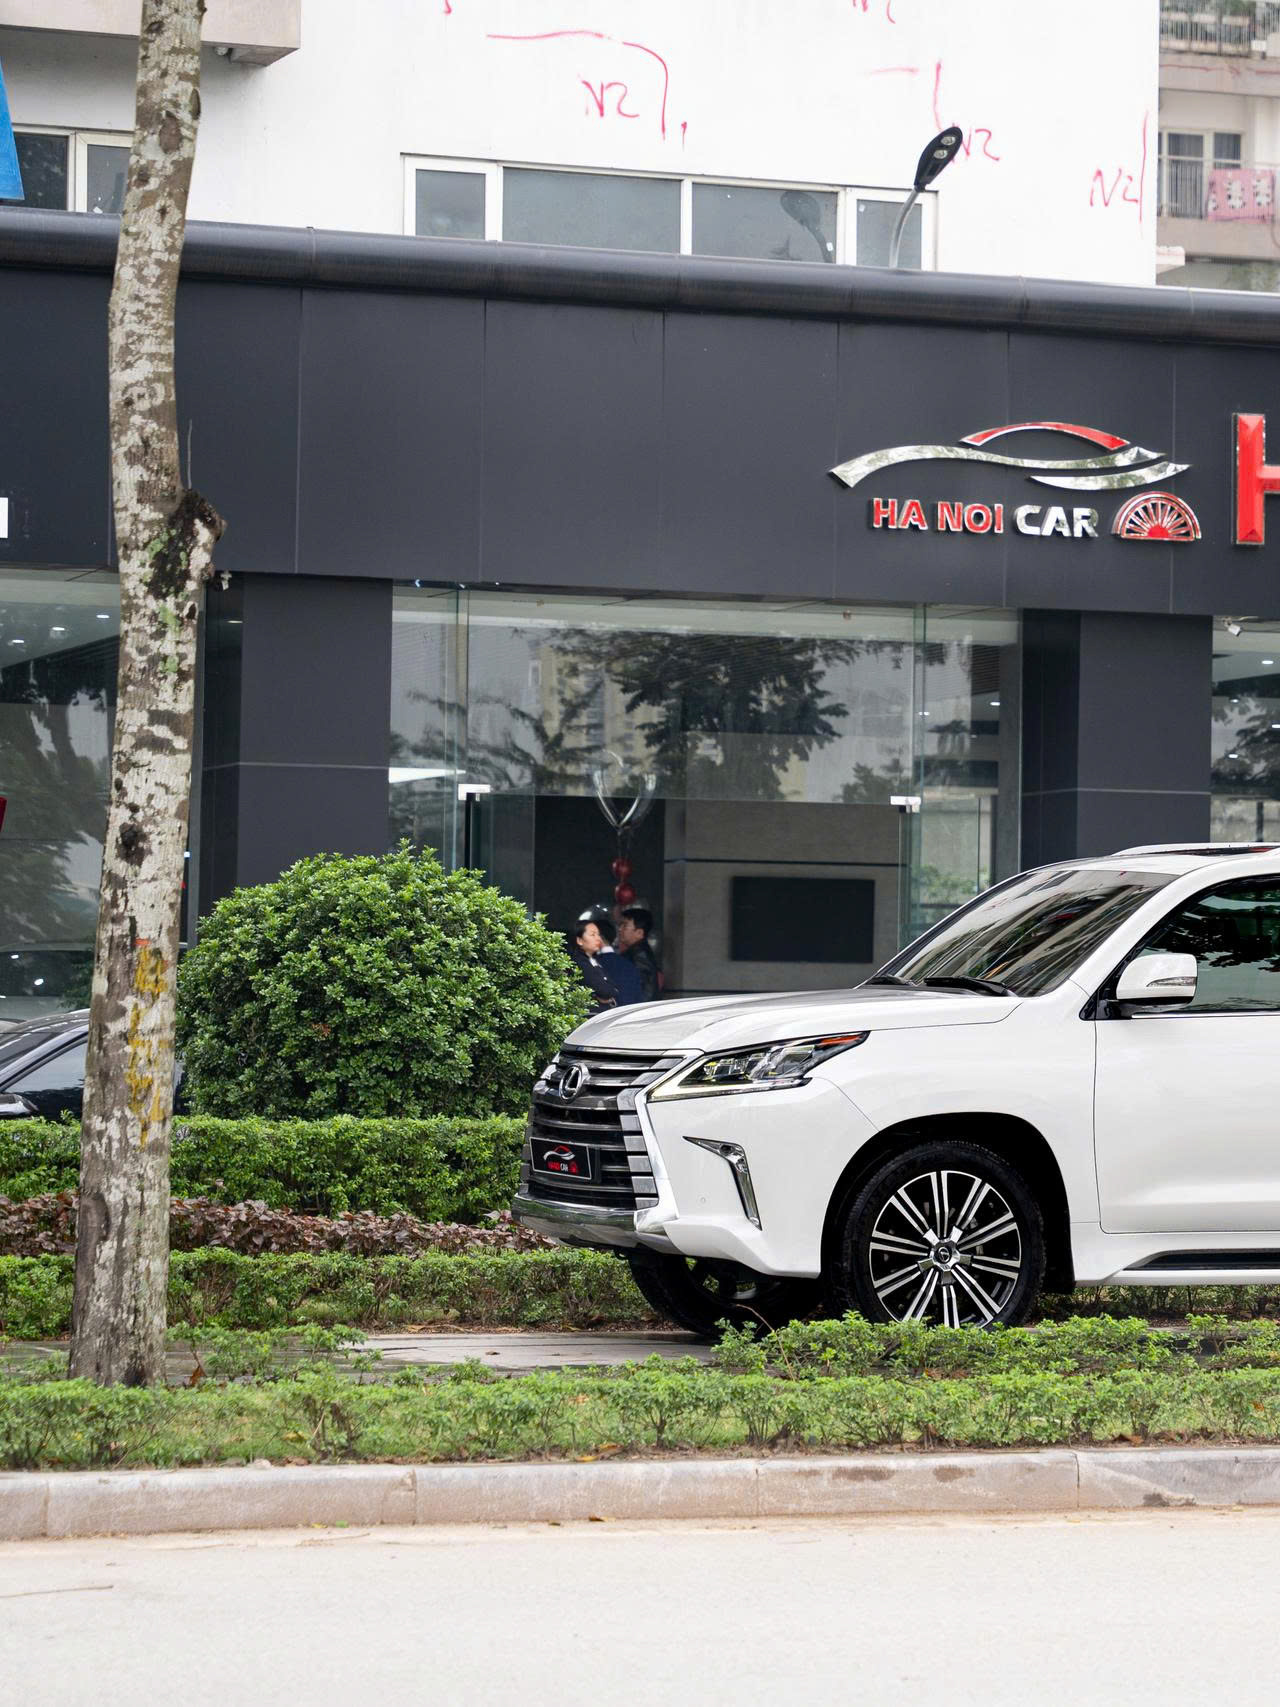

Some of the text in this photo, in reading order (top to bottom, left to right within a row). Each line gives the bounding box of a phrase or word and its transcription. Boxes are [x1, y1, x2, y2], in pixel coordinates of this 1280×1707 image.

[873, 497, 1099, 538] HA NOI CAR
